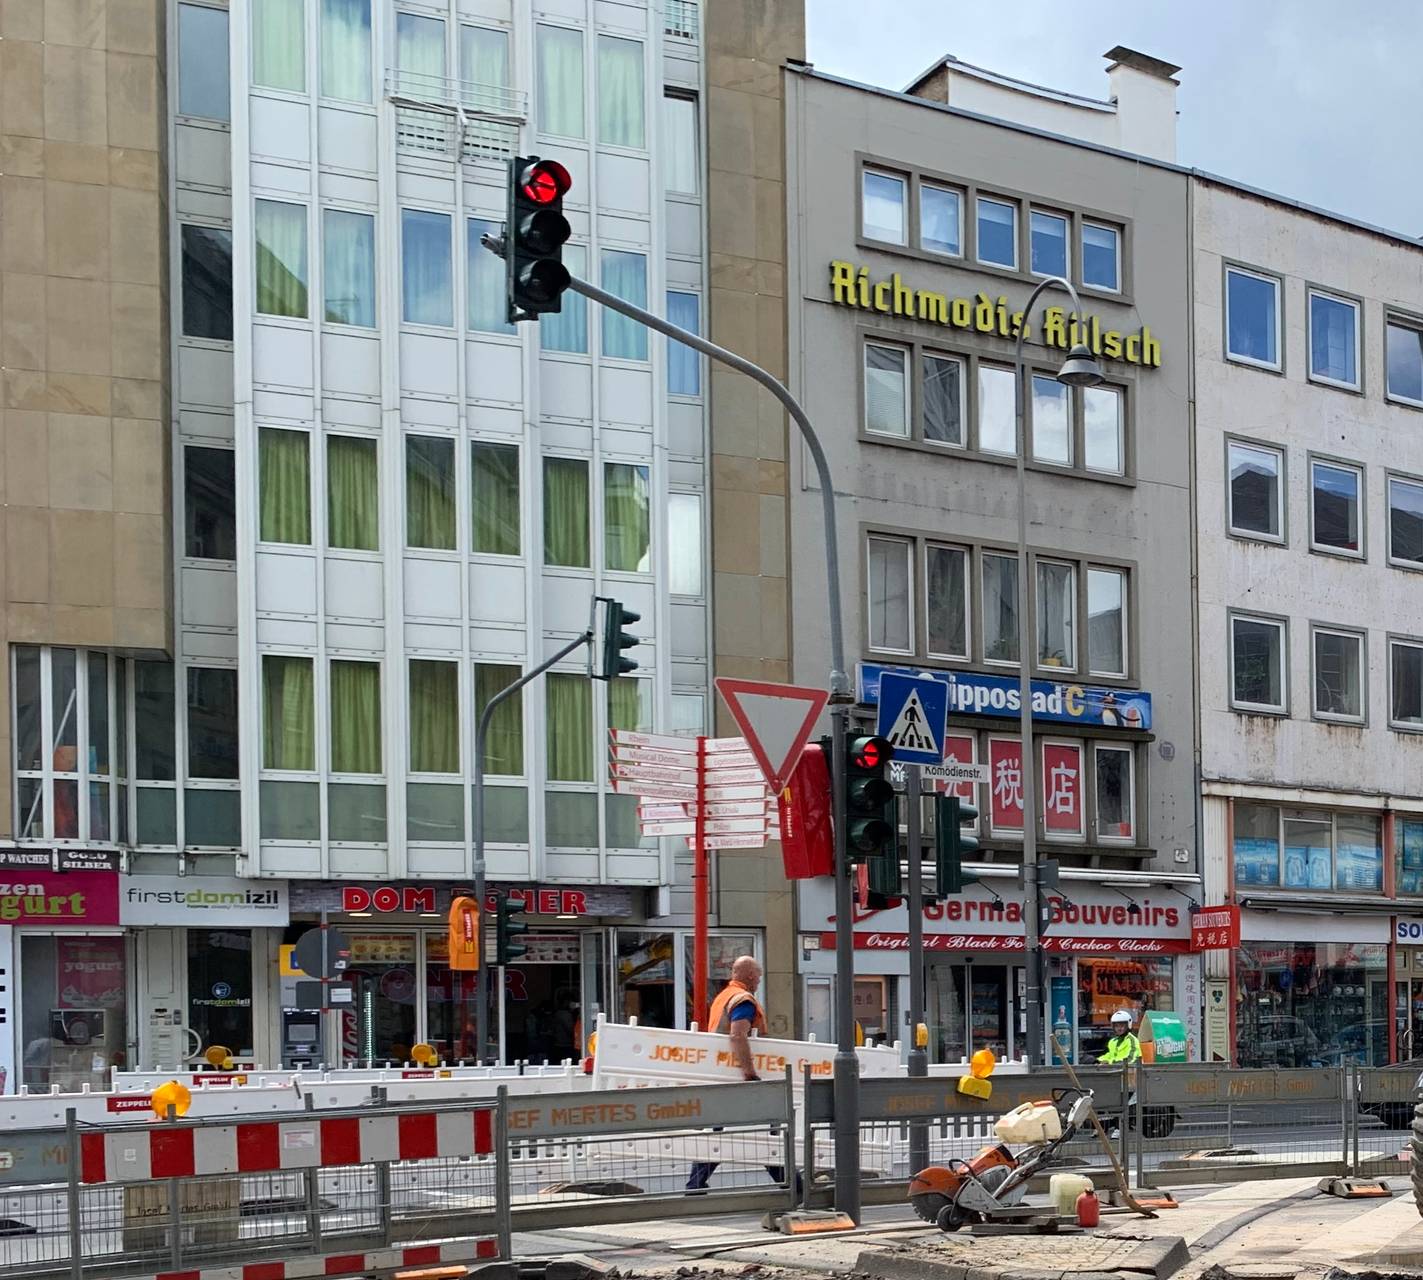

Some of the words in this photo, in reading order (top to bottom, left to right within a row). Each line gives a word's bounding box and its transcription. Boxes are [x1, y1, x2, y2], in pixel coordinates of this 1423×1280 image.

[832, 260, 1031, 341] Richmodis
[1044, 306, 1162, 368] Kölsch
[950, 675, 1064, 714] ipposad
[924, 765, 983, 779] Komödienstr.
[7, 853, 50, 864] WATCHES
[62, 861, 112, 870] SILBER
[126, 888, 279, 904] firstdomizil
[342, 886, 436, 913] DOM
[451, 882, 588, 915] ÖNER
[924, 900, 1021, 922] Germa
[1047, 896, 1179, 928] Souvenirs
[866, 934, 939, 949] Origial
[946, 936, 999, 949] Black
[1058, 938, 1113, 951] Cuckoo
[1118, 938, 1164, 951] Clocks
[649, 1045, 708, 1064] JOSEF
[716, 1051, 787, 1072] METES
[116, 1100, 152, 1108] ZEPPELI
[507, 1110, 541, 1130] SEF
[551, 1104, 637, 1127] MERTES
[647, 1098, 702, 1121] GmbH
